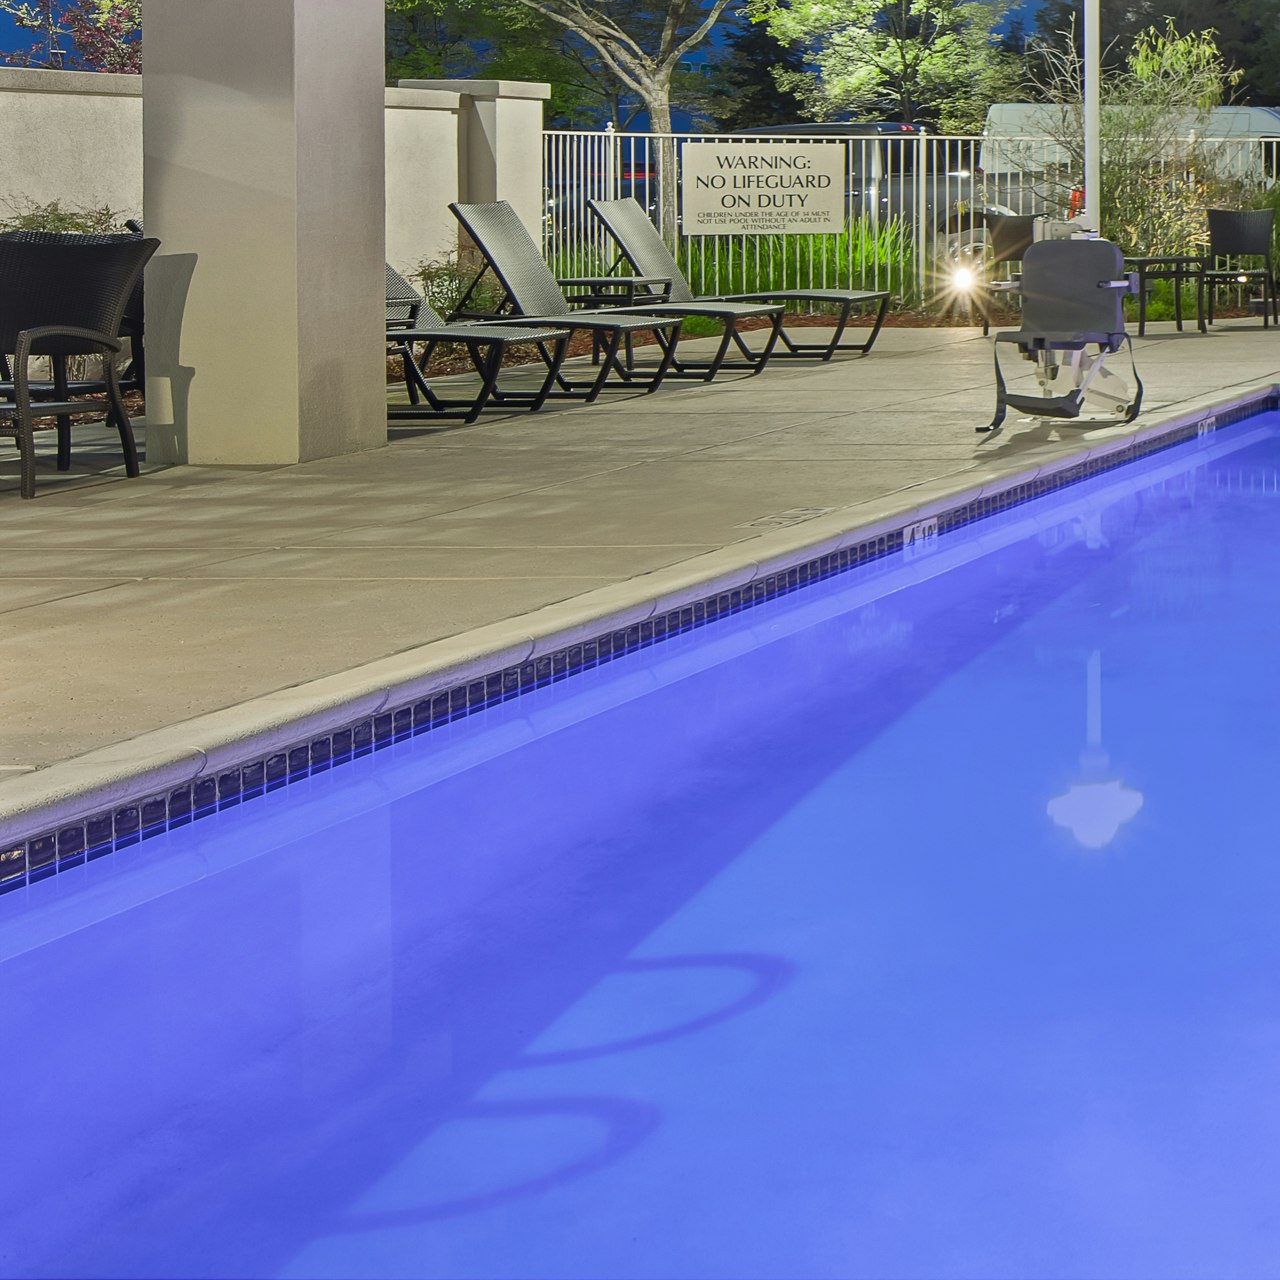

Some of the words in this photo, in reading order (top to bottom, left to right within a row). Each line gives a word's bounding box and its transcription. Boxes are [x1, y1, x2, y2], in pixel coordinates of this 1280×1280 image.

[716, 155, 811, 170] WARNING:
[696, 175, 726, 189] NO
[733, 174, 831, 189] LIFEGUARD
[721, 194, 751, 209] ON
[758, 194, 808, 208] DUTY
